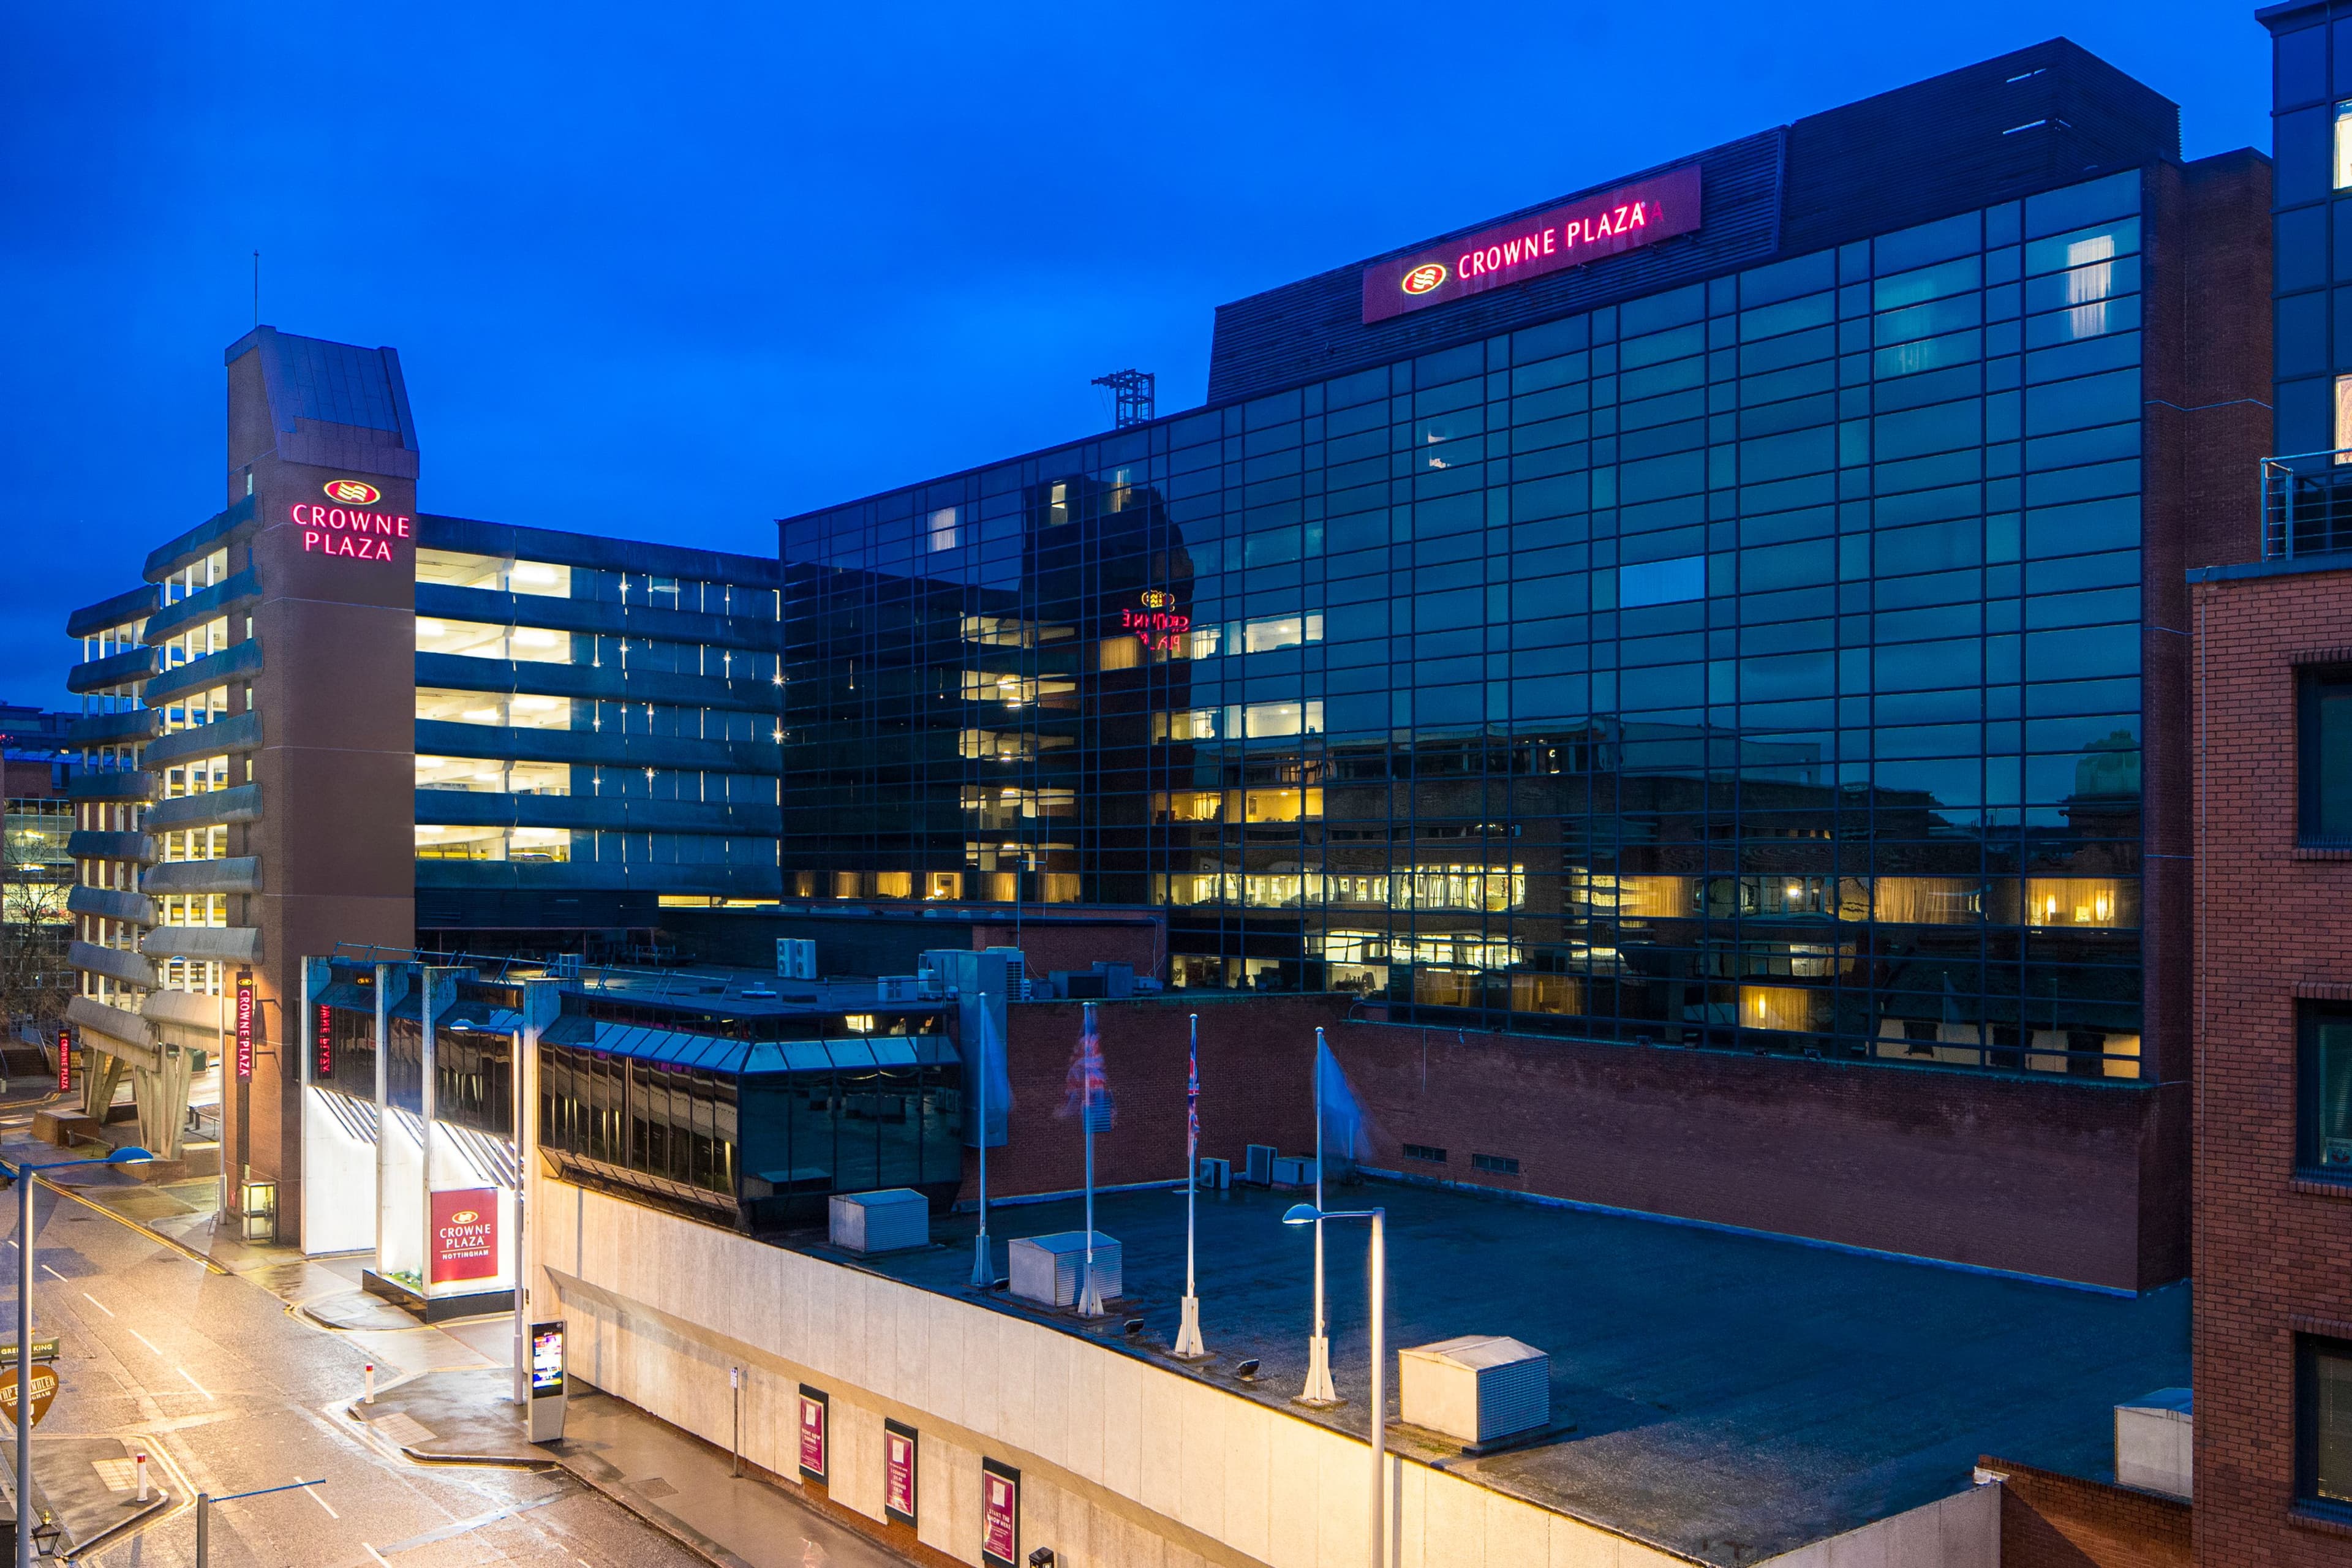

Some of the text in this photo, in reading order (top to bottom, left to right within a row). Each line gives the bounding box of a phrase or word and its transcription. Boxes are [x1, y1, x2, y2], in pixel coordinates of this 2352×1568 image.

[1458, 202, 1645, 279] CROWNE PLAZA
[292, 503, 410, 538] CROWNE
[305, 530, 392, 562] PLAZA
[239, 989, 251, 1076] CROWNE PLAZA
[440, 1224, 491, 1238] CROWNE
[446, 1235, 484, 1249] PLAZA
[442, 1250, 489, 1260] NOTTINGHAM
[33, 1343, 53, 1352] KING
